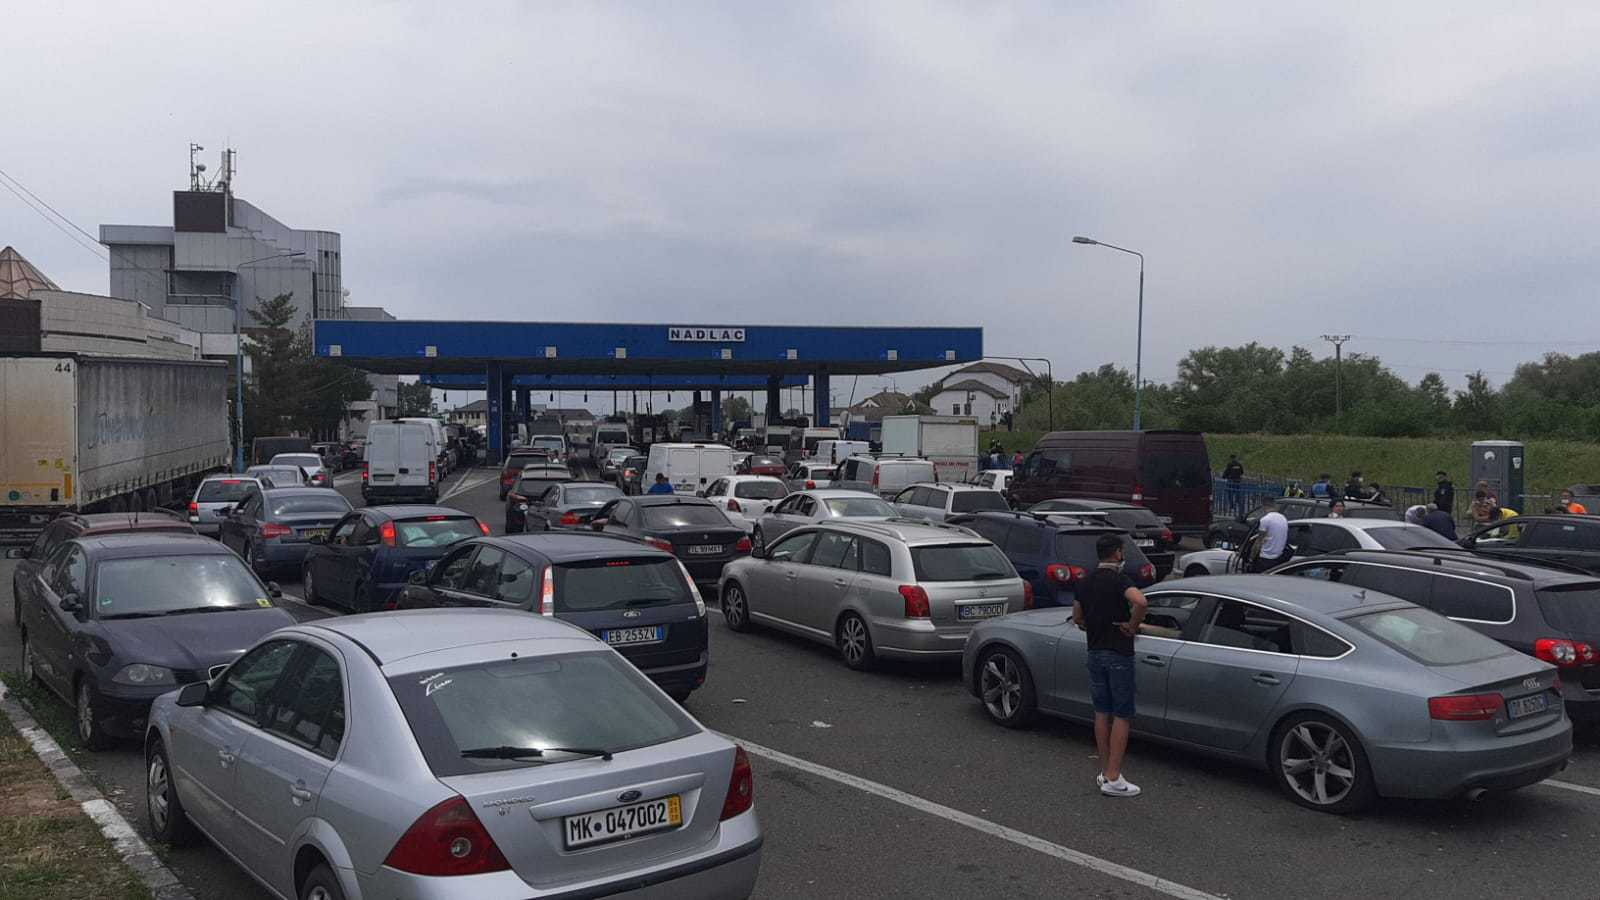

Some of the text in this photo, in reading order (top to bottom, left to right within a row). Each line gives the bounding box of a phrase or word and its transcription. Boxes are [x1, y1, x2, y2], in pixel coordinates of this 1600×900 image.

[671, 329, 743, 340] NADLAC
[55, 363, 71, 373] 44
[570, 816, 593, 841] MK
[606, 802, 667, 834] 047002
